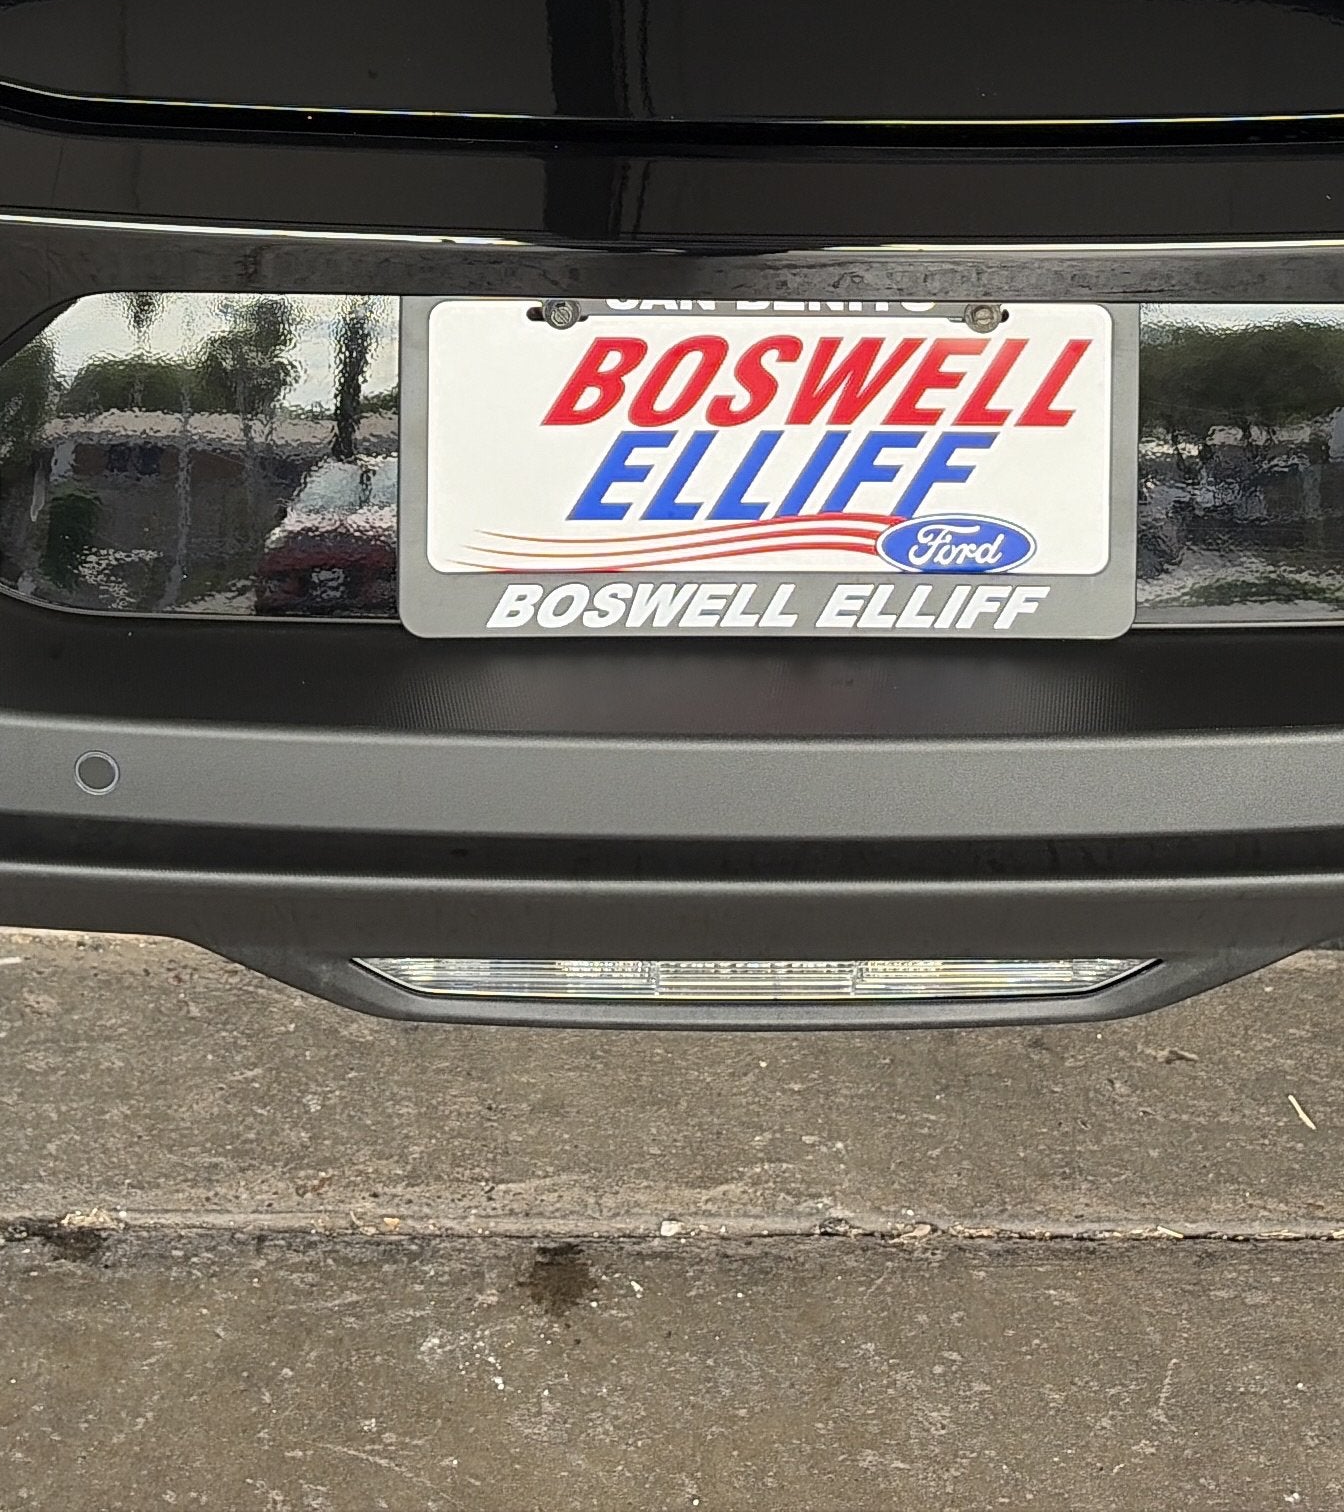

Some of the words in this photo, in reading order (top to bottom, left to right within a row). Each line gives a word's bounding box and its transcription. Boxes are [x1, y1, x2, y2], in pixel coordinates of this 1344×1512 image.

[541, 334, 1093, 428] BOSWELL
[566, 430, 1000, 522] ELLIFF
[908, 523, 1005, 567] Ford
[486, 582, 799, 630] BOSWELL
[814, 583, 1052, 630] ELLIFF
